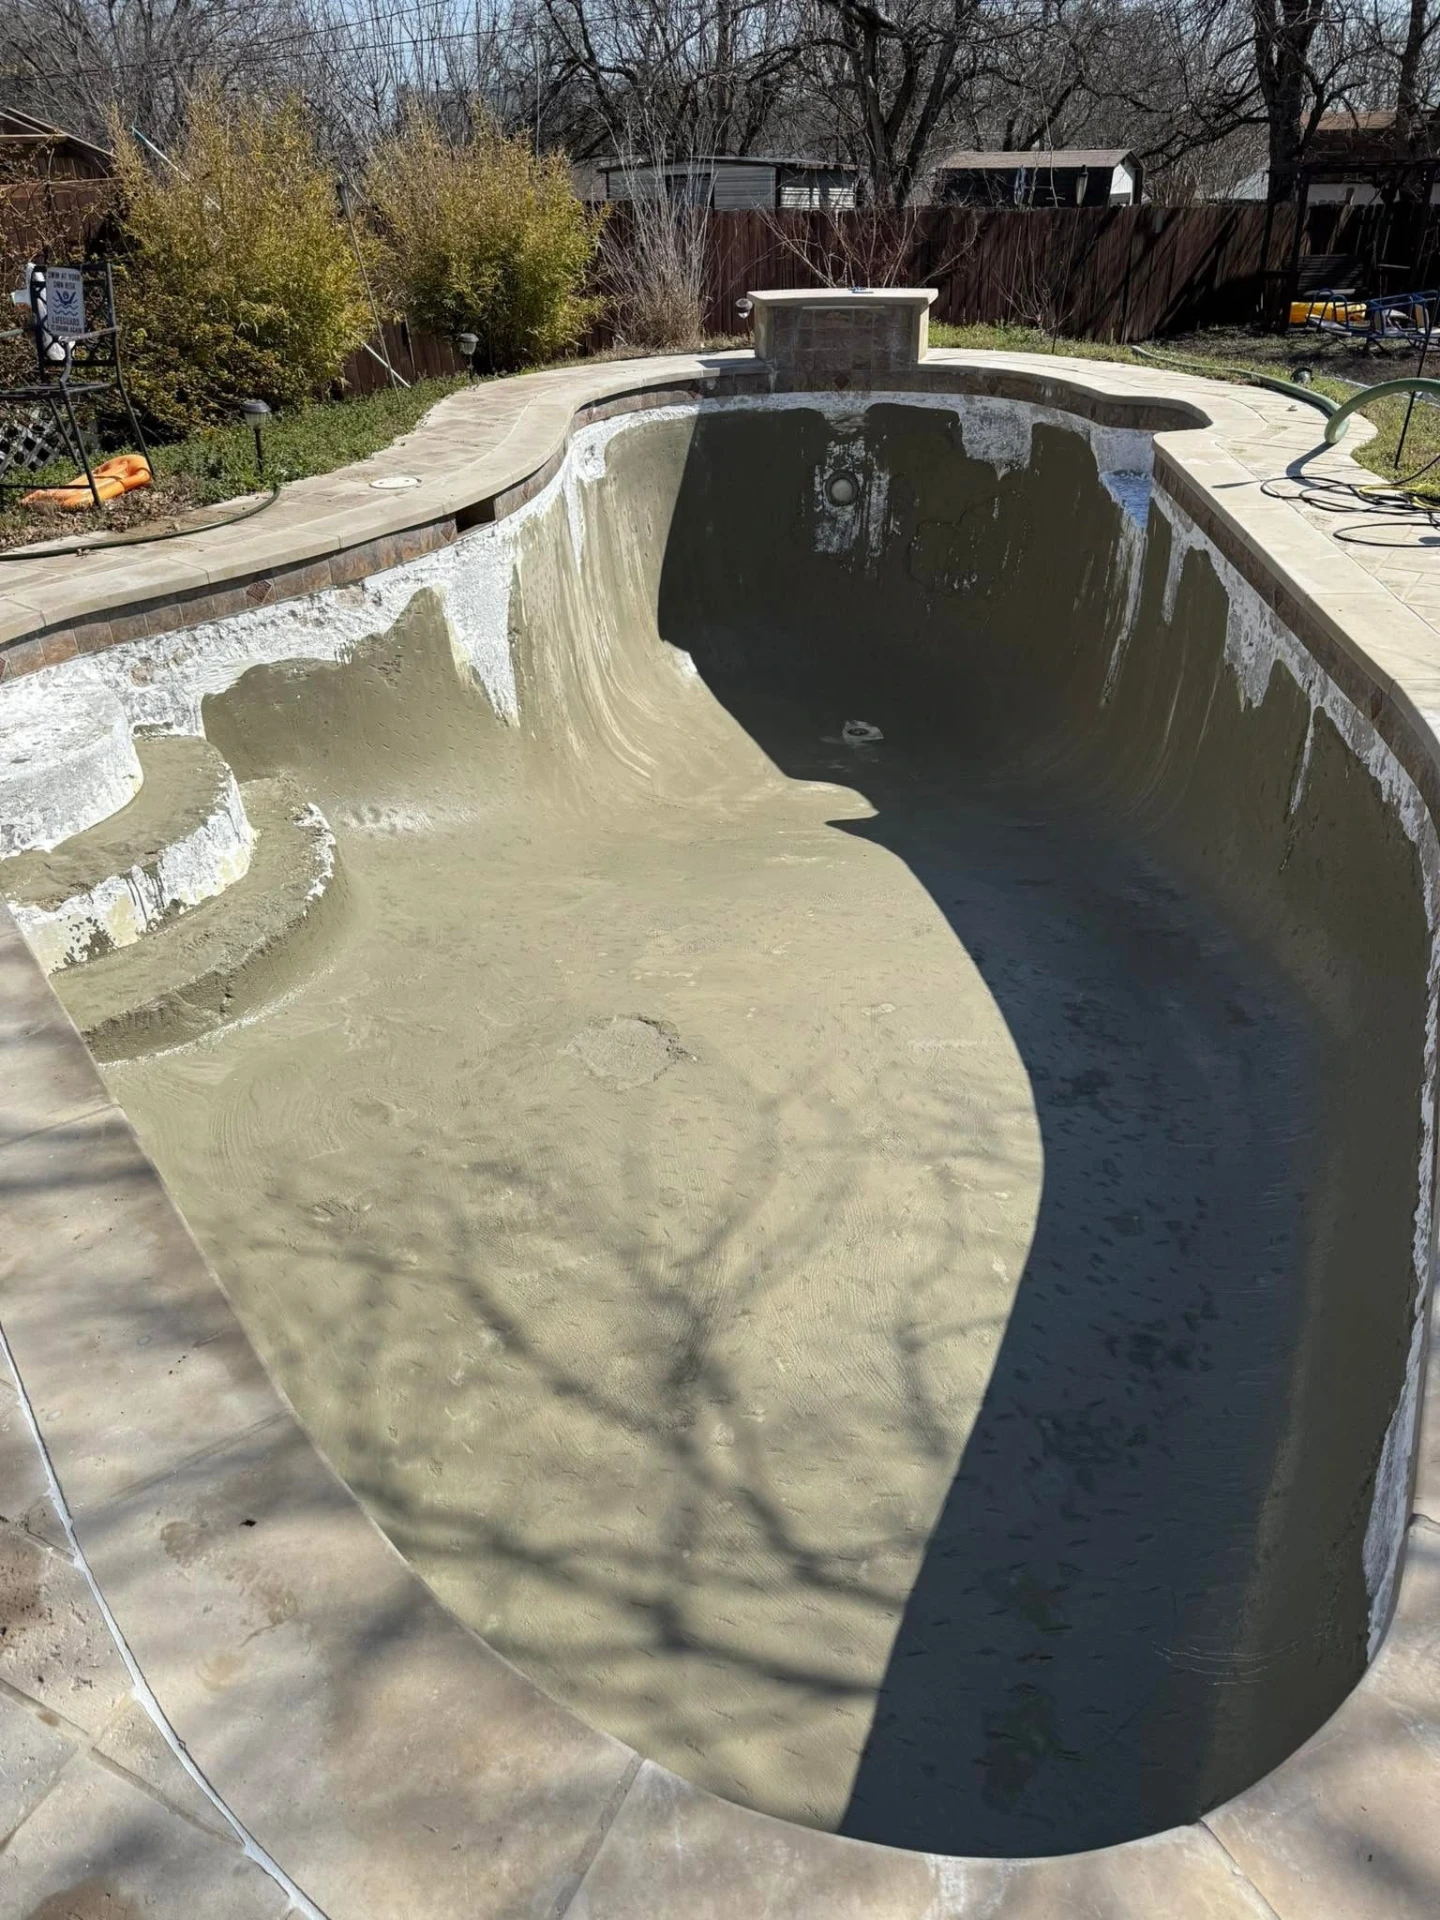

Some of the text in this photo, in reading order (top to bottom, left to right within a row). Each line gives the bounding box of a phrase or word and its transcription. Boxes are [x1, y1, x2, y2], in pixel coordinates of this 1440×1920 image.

[53, 281, 75, 290] OWN RISK
[52, 316, 80, 326] LIFEGUARD
